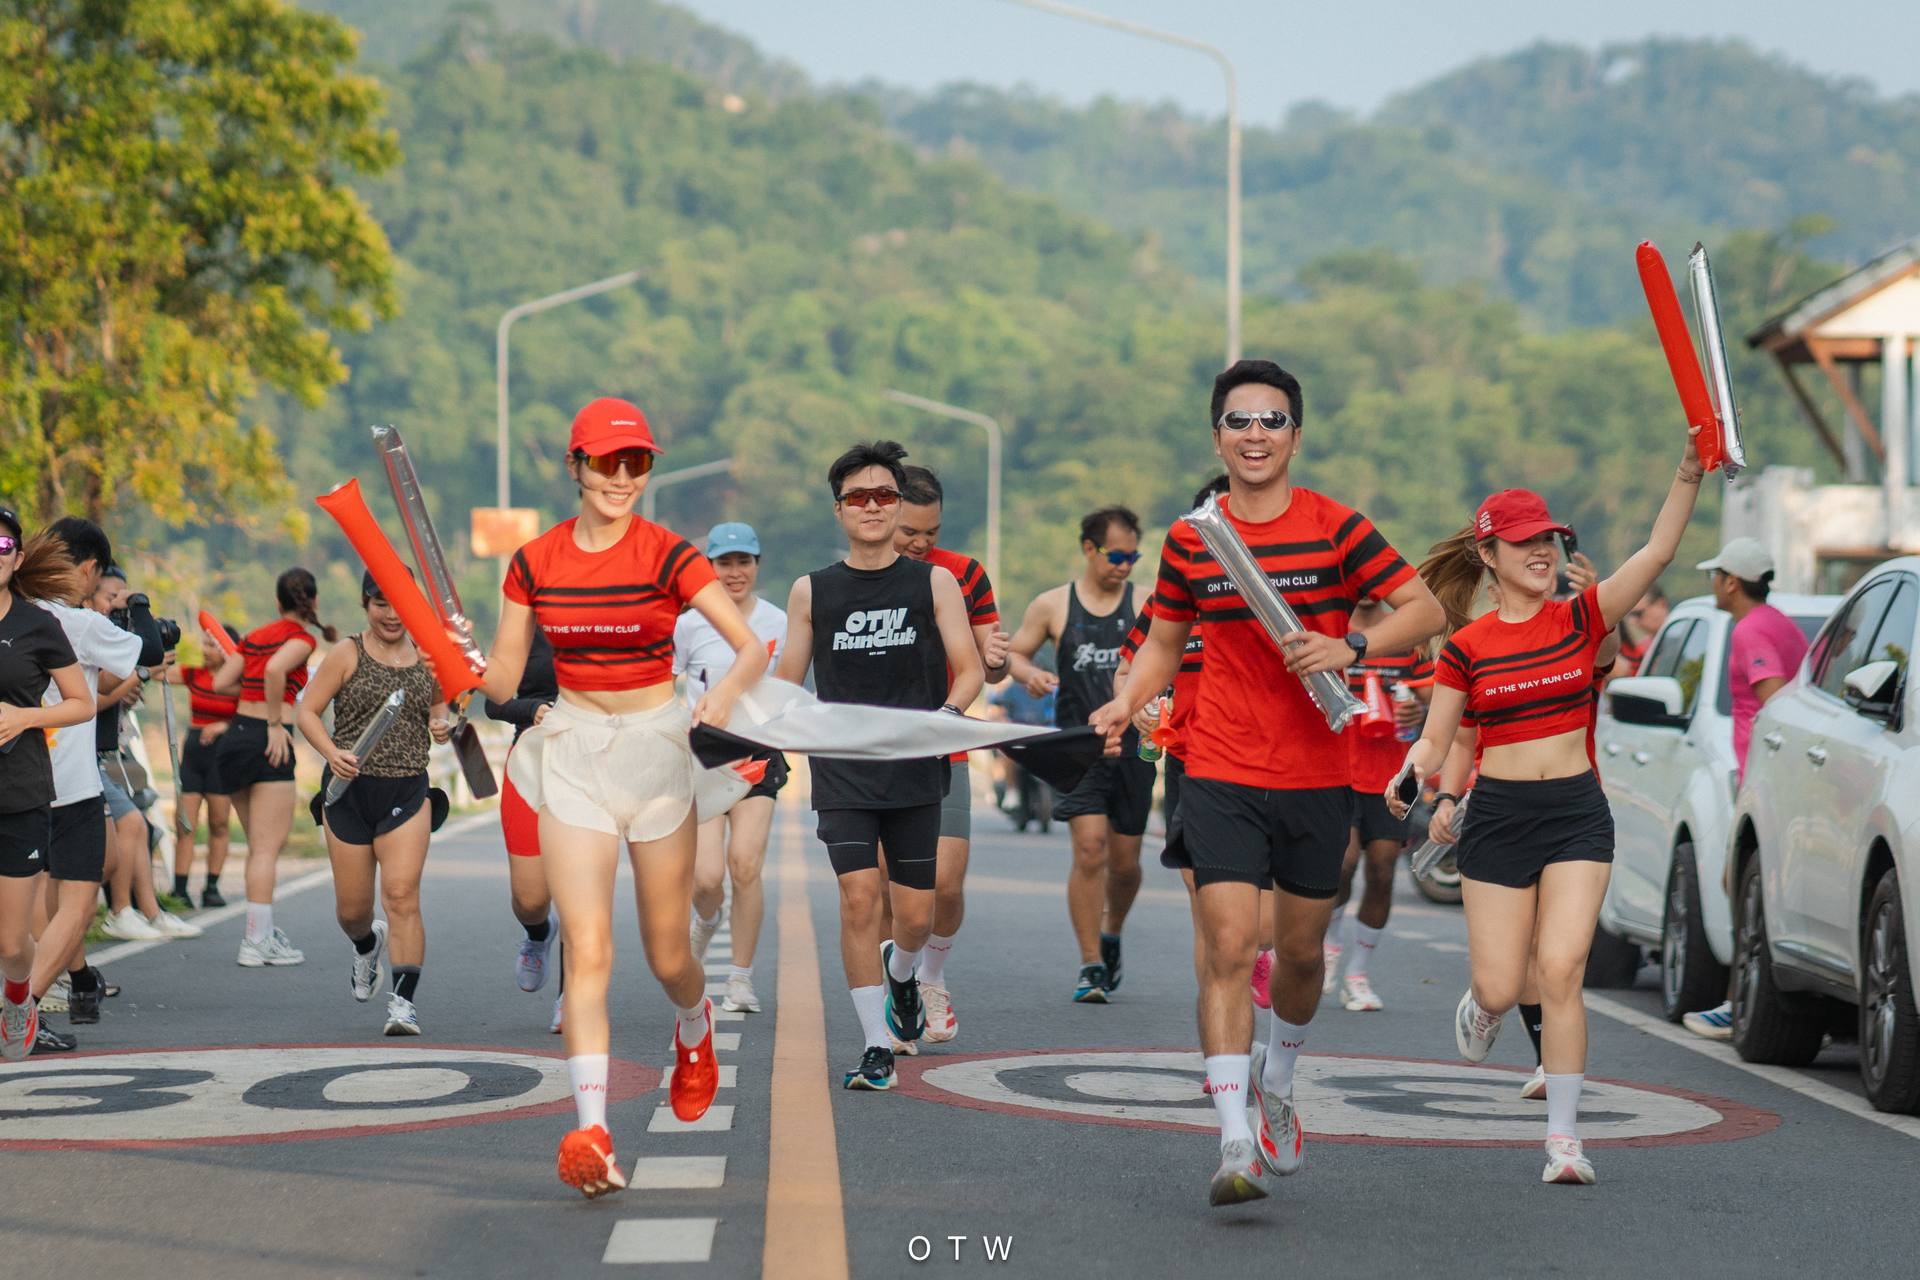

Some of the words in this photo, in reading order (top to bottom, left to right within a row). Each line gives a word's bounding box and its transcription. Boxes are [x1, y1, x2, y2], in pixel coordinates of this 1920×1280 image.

[1207, 583, 1220, 592] ON
[1222, 581, 1237, 590] TH
[1292, 575, 1318, 586] CLUB
[552, 625, 569, 634] THE
[571, 625, 593, 633] WAY
[594, 625, 613, 633] RUN
[615, 624, 640, 634] CLUB
[845, 607, 908, 634] OTW
[1485, 688, 1497, 696] ON
[1499, 684, 1517, 693] THE
[1518, 680, 1540, 690] WAY
[1542, 675, 1561, 685] RUN
[1563, 668, 1583, 681] CLUB
